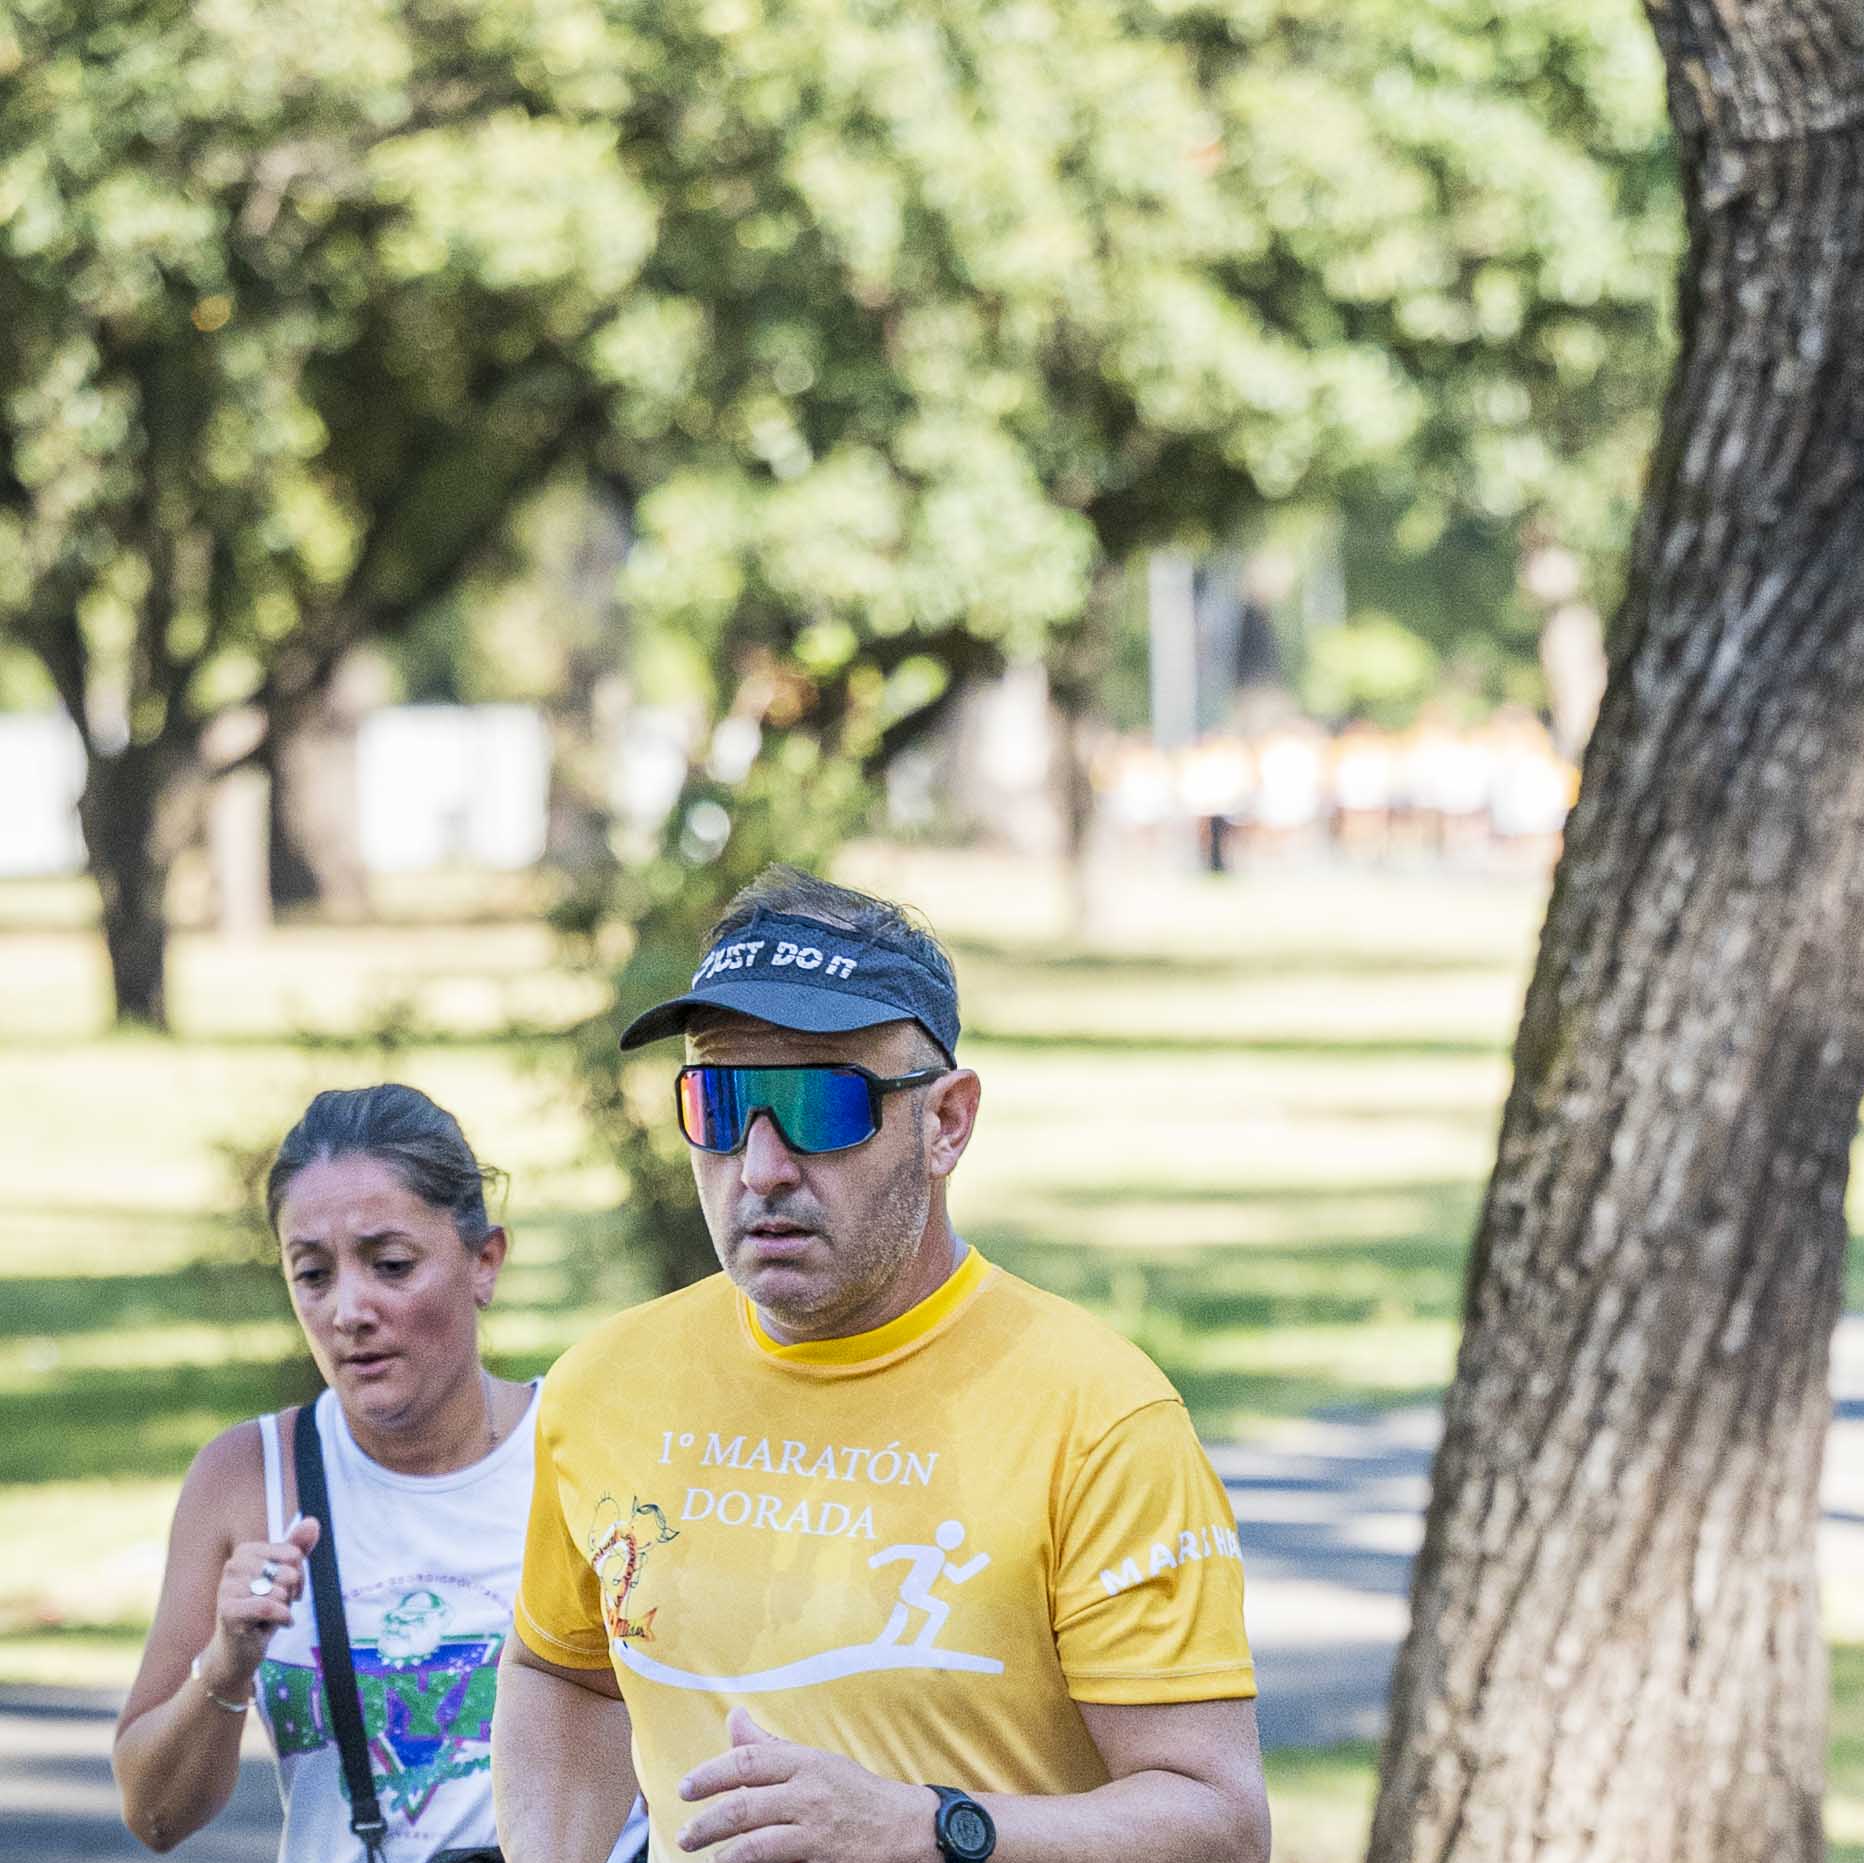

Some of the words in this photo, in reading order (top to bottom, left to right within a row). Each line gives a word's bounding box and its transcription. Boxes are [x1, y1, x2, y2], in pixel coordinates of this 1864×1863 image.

[771, 941, 824, 970] DO
[700, 1432, 940, 1487] MARATÓN
[680, 1487, 878, 1540] DORADA
